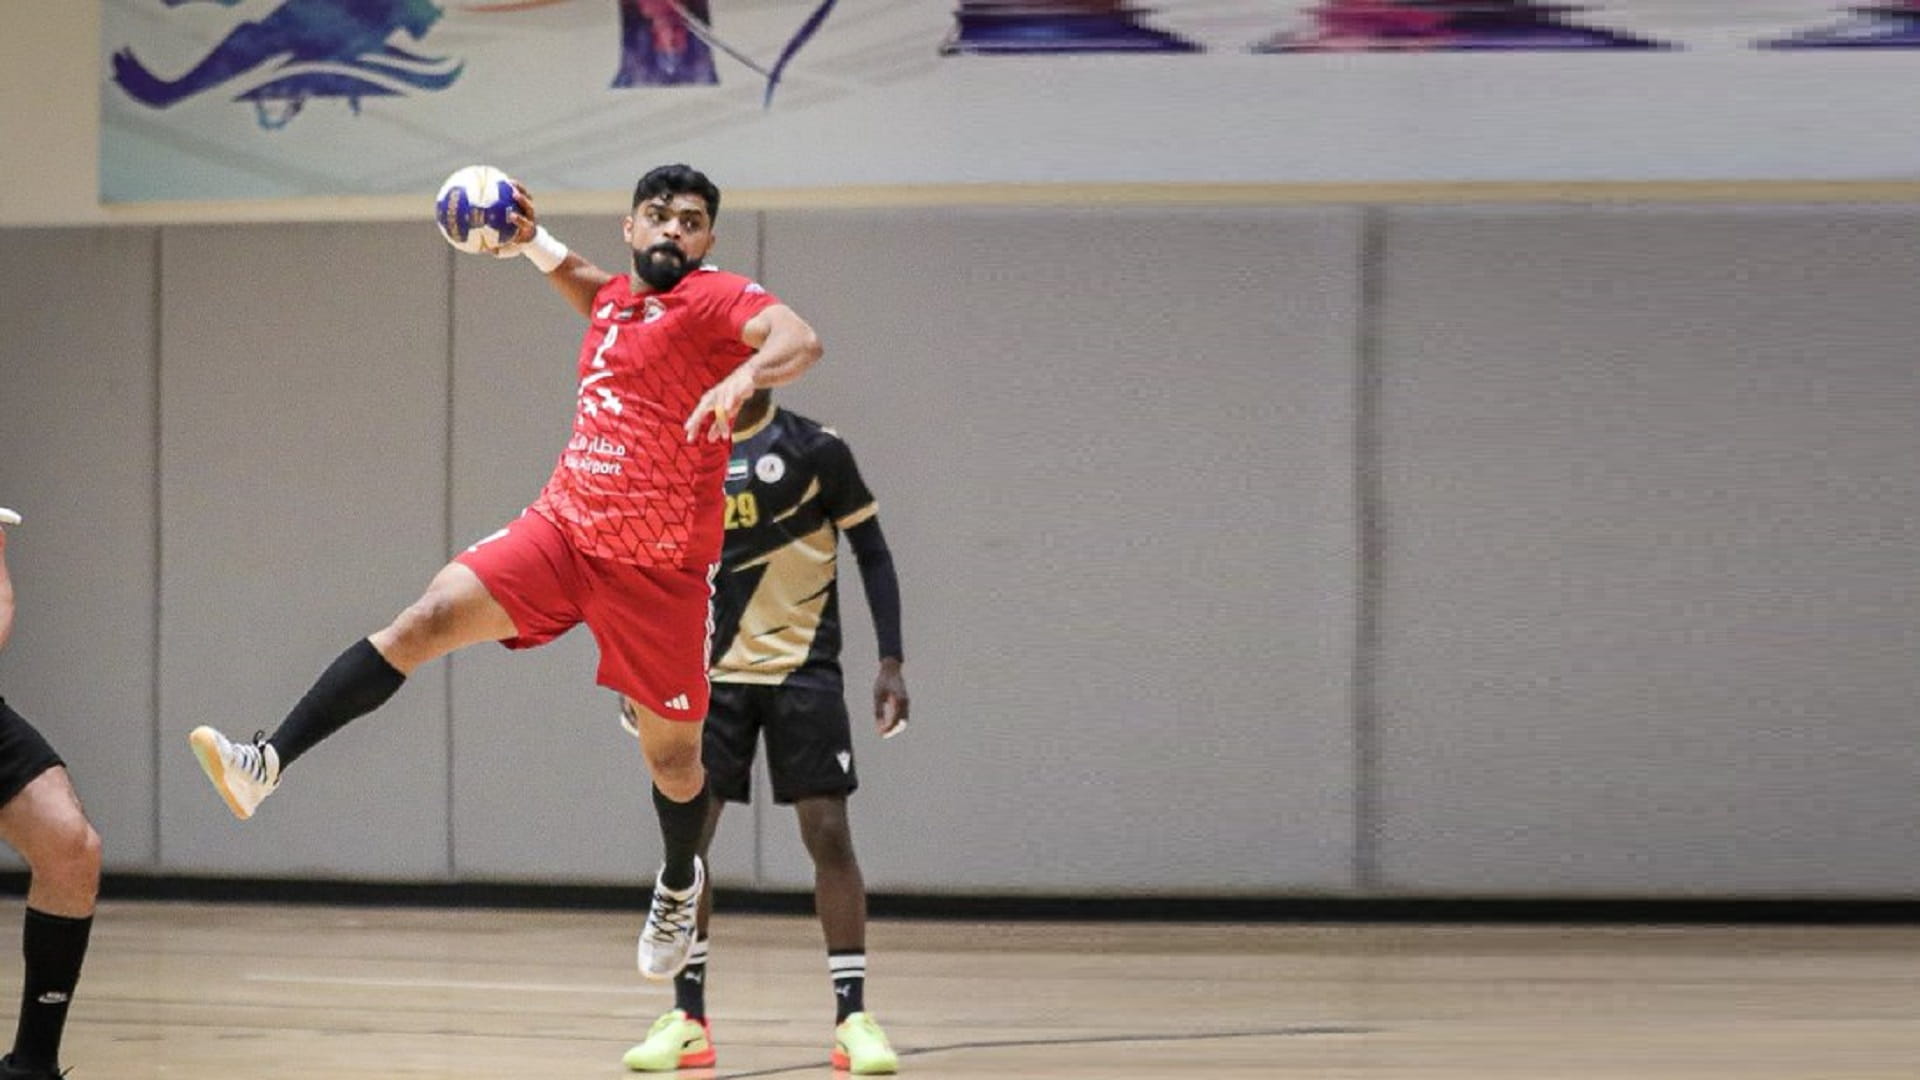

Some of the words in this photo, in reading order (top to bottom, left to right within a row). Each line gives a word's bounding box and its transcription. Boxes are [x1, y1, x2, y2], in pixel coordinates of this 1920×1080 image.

[591, 324, 618, 369] 2
[578, 456, 622, 477] Airport
[724, 493, 758, 530] 29
